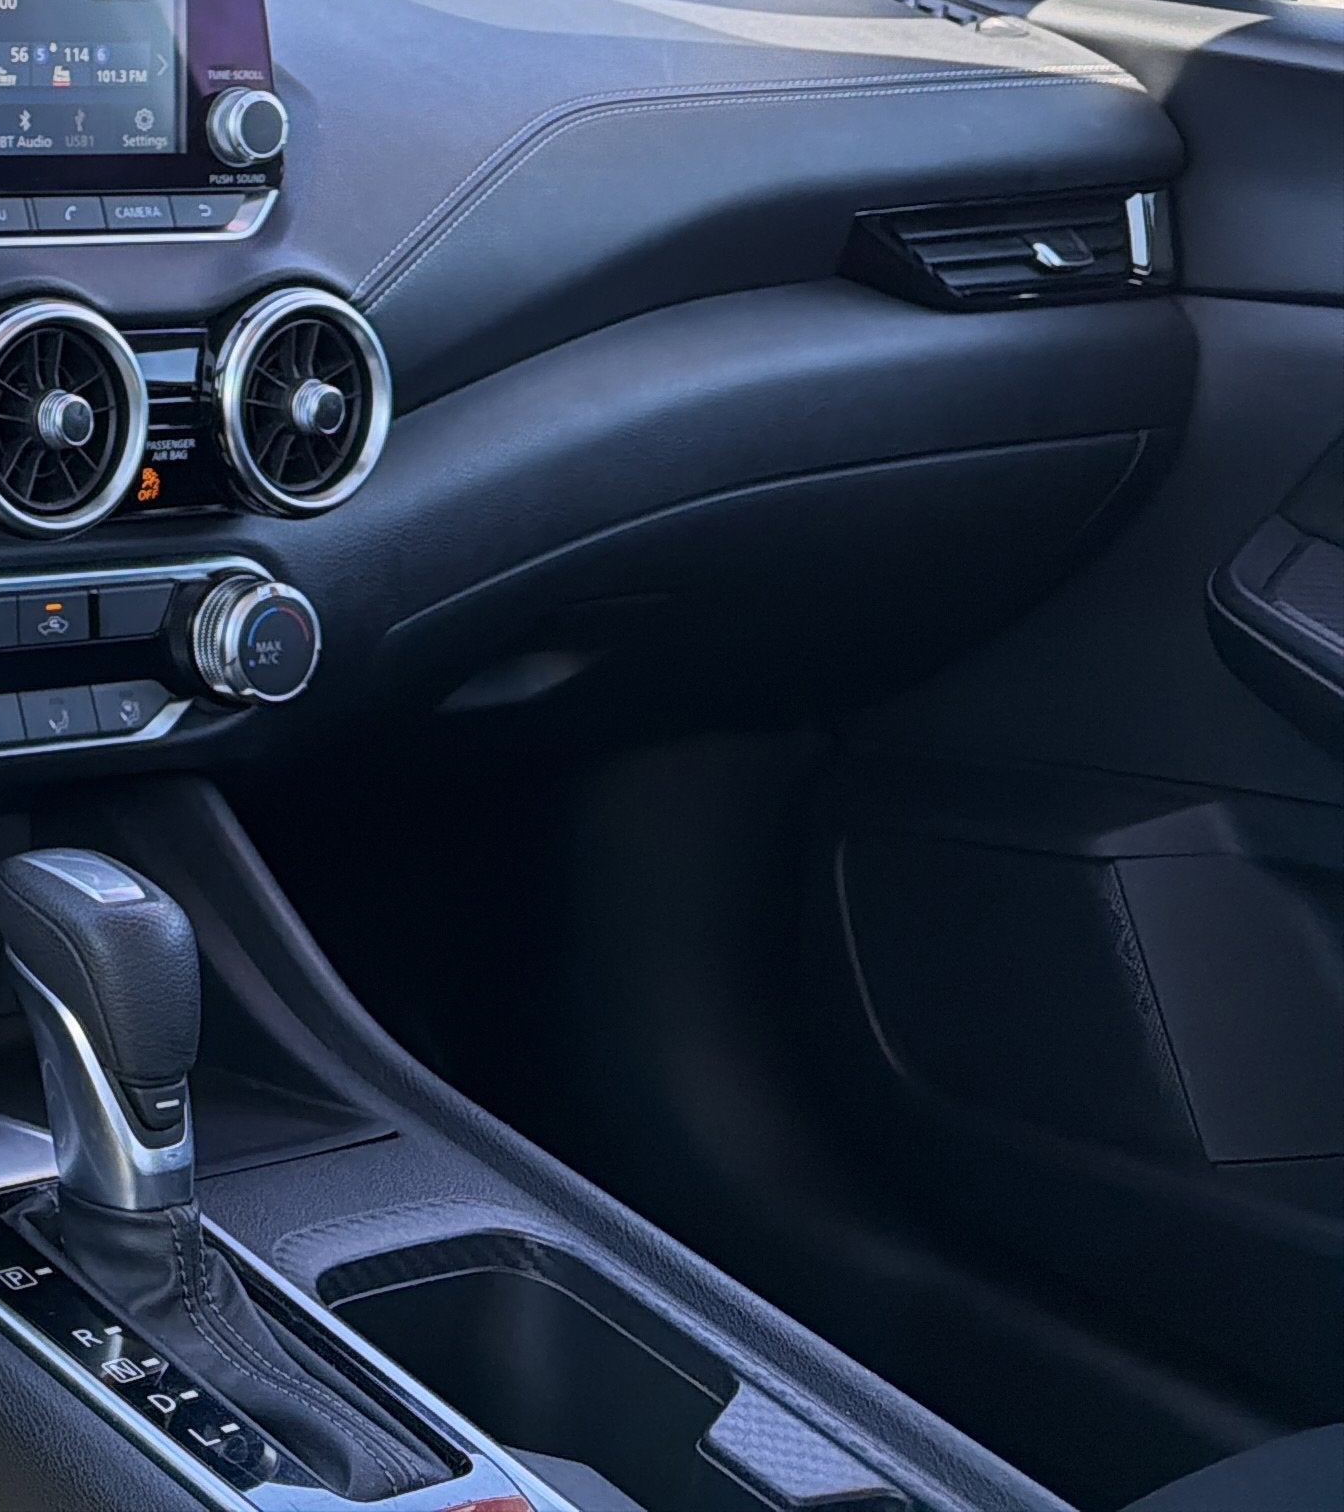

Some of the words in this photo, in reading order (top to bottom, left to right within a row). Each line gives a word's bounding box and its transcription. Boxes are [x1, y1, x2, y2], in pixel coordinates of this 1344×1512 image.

[11, 47, 29, 63] 56
[64, 47, 90, 62] 114
[97, 70, 127, 83] 101.3
[129, 70, 148, 83] FM
[0, 136, 14, 148] BT
[16, 136, 53, 148] Audio
[122, 135, 168, 150] Settings
[209, 174, 233, 185] PUSH
[236, 173, 266, 185] SOUND
[114, 206, 162, 219] CAMERA
[138, 489, 160, 501] OFF
[256, 640, 283, 653] MAX
[71, 1328, 104, 1348] R
[147, 1394, 179, 1413] D
[188, 1426, 222, 1448] L
